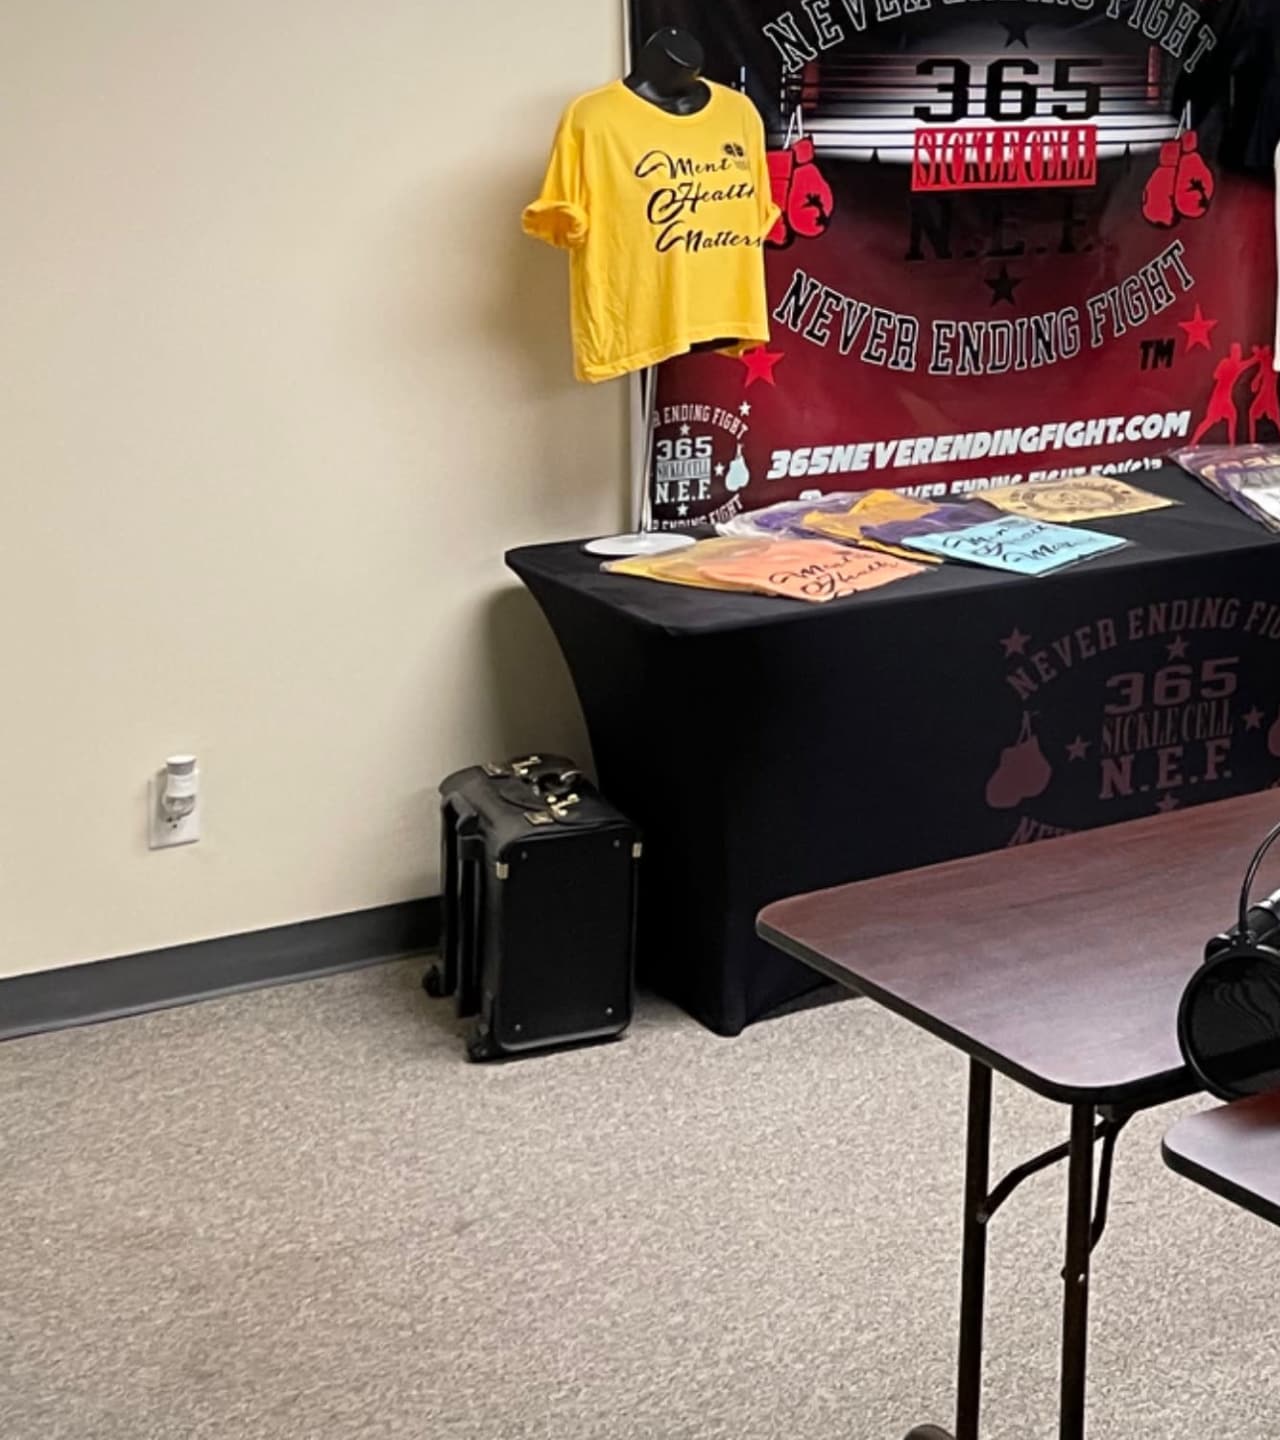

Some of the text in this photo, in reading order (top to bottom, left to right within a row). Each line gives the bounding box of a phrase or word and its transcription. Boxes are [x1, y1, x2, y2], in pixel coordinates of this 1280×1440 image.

[914, 58, 1103, 123] 365
[916, 128, 1093, 186] SICKLE CELL
[773, 241, 1195, 375] NEVER ENDING FIGHT
[1139, 339, 1175, 370] TM
[656, 436, 713, 460] 365
[663, 404, 711, 424] ENDING
[711, 407, 749, 440] FIGHT
[767, 410, 1191, 480] 365NEVERENDINGFIGHT.COM
[655, 479, 711, 504] N.E.F.
[1006, 618, 1118, 700] NEVER
[1128, 597, 1240, 640] ENDING
[1104, 656, 1240, 714] 365
[1103, 699, 1234, 755] SICKLE CELL
[1099, 736, 1232, 799] N.E.F.
